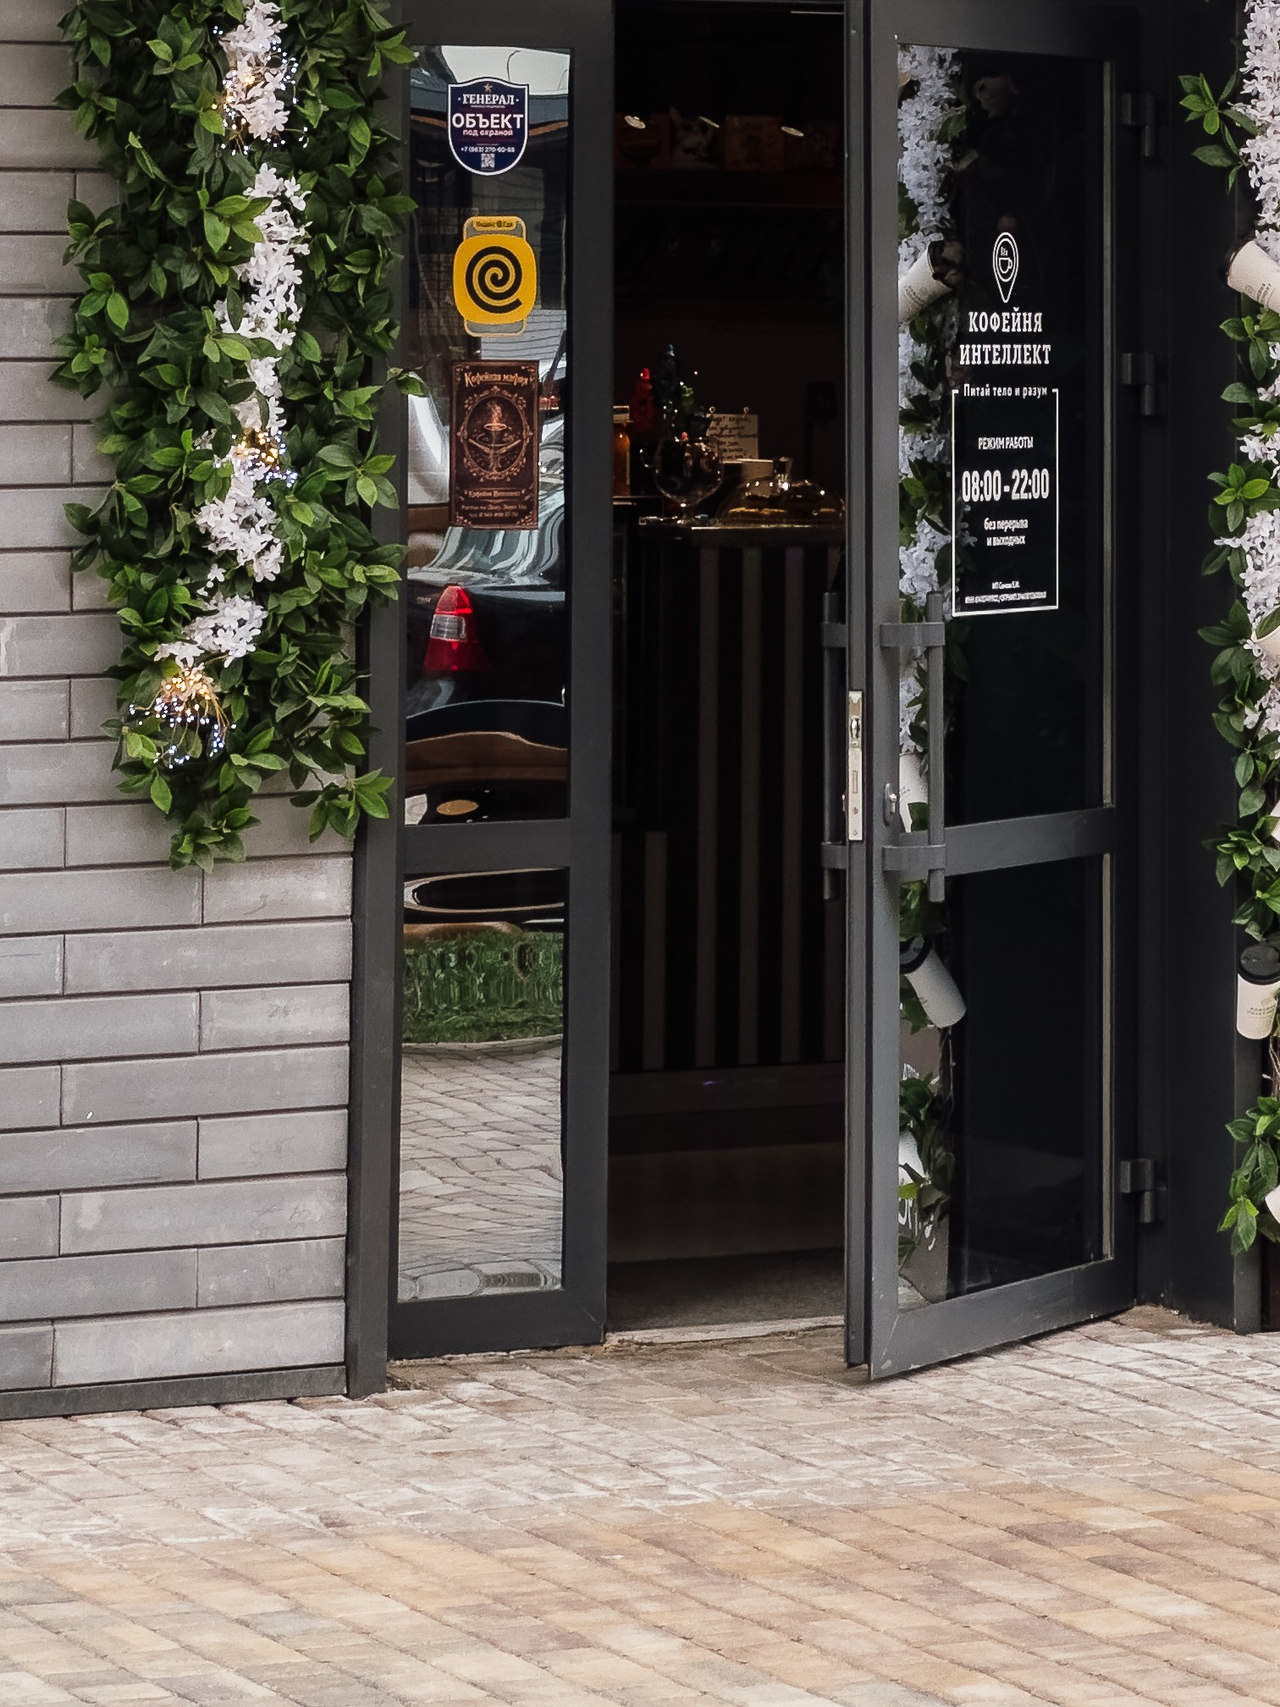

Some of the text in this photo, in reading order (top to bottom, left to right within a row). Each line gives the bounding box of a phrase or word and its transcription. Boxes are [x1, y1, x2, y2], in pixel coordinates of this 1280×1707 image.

[462, 94, 514, 105] ГЕНЕРАЛ
[452, 113, 524, 129] ОБЪЕКТ
[968, 306, 1043, 333] КОФЕЙНЯ
[960, 344, 1051, 365] ИНТЕЛЛЕКТ
[964, 383, 1047, 399] Питай тело и разум
[978, 436, 1034, 450] РЕЖИМ РАБОТЫ
[984, 517, 996, 531] без
